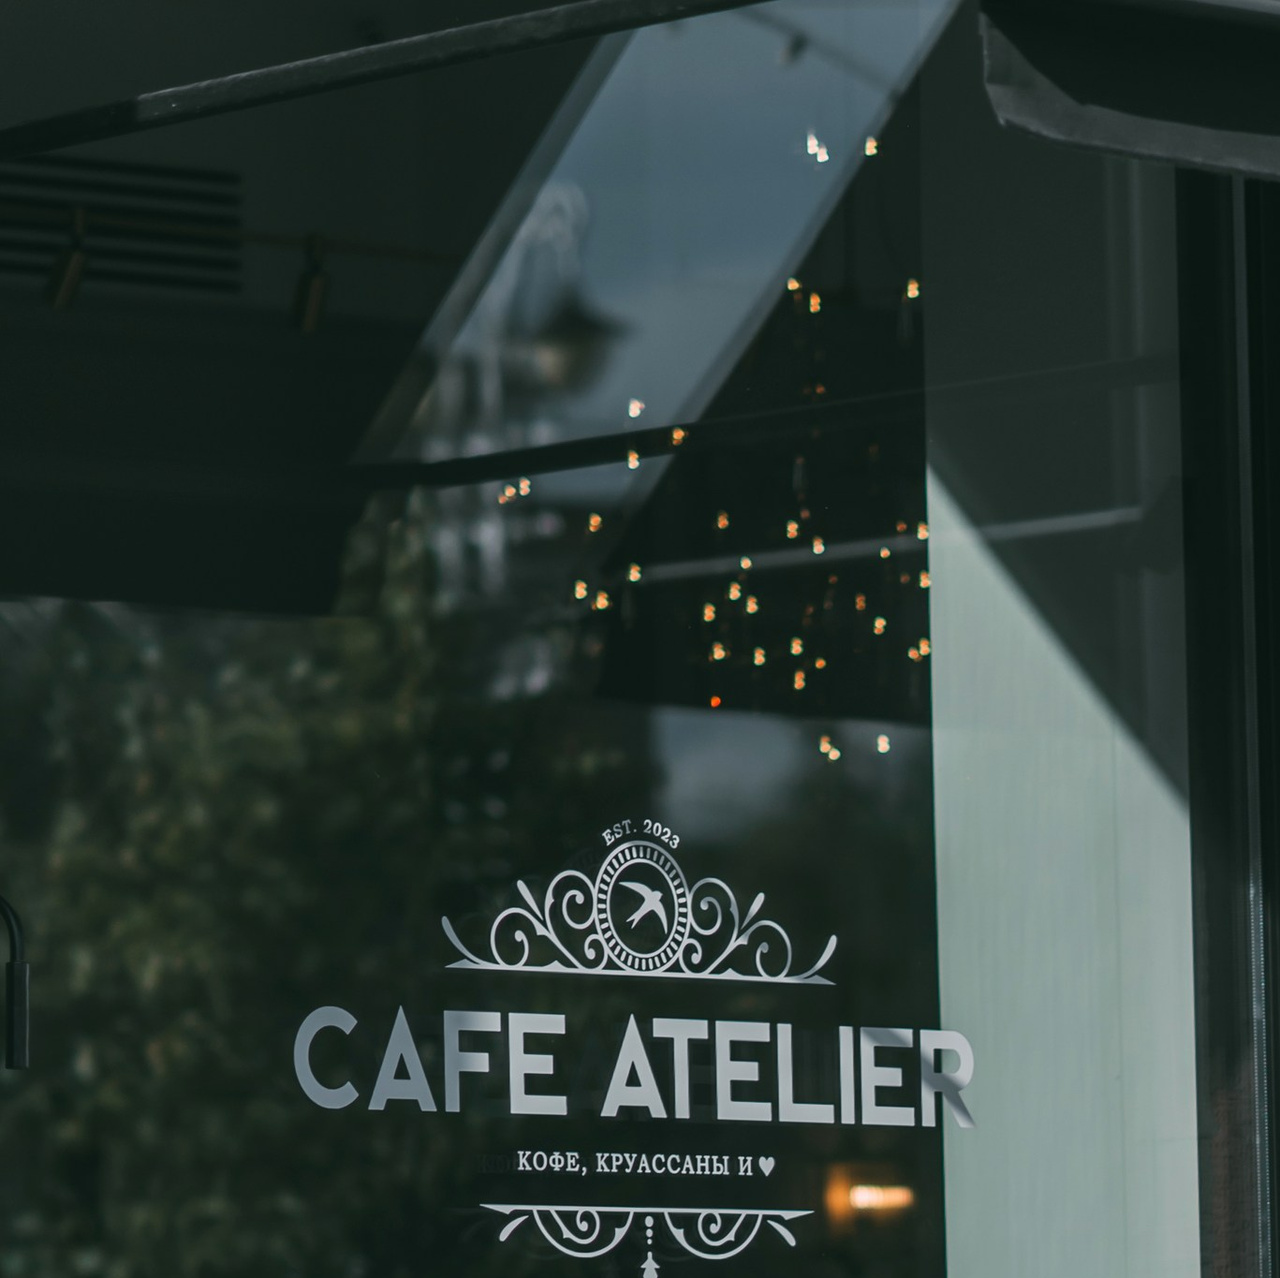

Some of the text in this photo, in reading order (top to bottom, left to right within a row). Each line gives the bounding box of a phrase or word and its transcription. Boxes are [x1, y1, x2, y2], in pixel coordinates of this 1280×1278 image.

[601, 819, 680, 849] EST. 2023
[293, 1005, 976, 1129] CAFE ATELIER
[517, 1151, 754, 1176] КОФЕ, КРУАССАНЫ И
